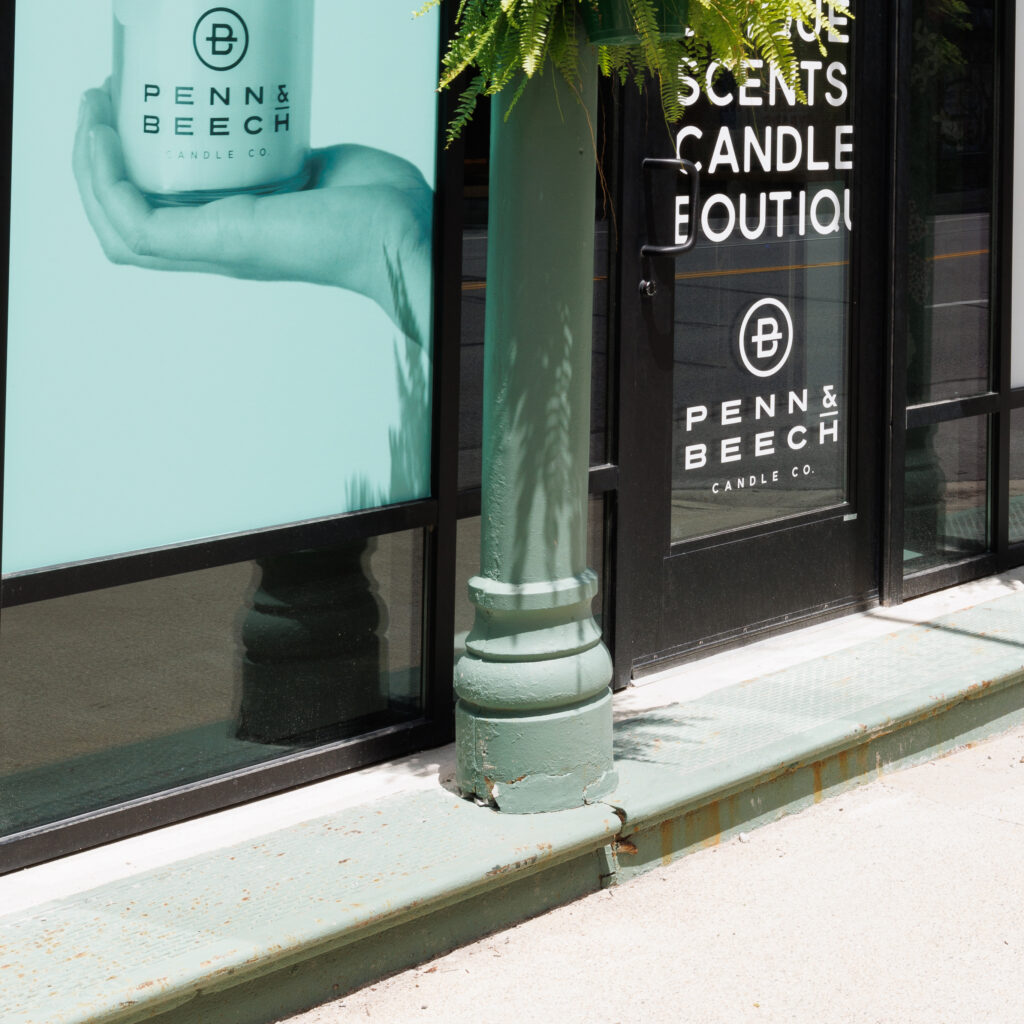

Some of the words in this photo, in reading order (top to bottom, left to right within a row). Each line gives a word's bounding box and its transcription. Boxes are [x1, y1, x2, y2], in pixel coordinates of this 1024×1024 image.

[144, 83, 264, 106] PENN
[276, 84, 289, 104] &
[677, 57, 848, 107] SCENTS
[143, 112, 290, 136] BEECH
[166, 149, 234, 160] CANDLE
[676, 125, 853, 175] CANDLE
[686, 388, 808, 432] PENN
[822, 384, 838, 409] &
[684, 419, 838, 471] BEECH
[711, 470, 779, 494] CANDLE
[791, 464, 815, 478] CO.
